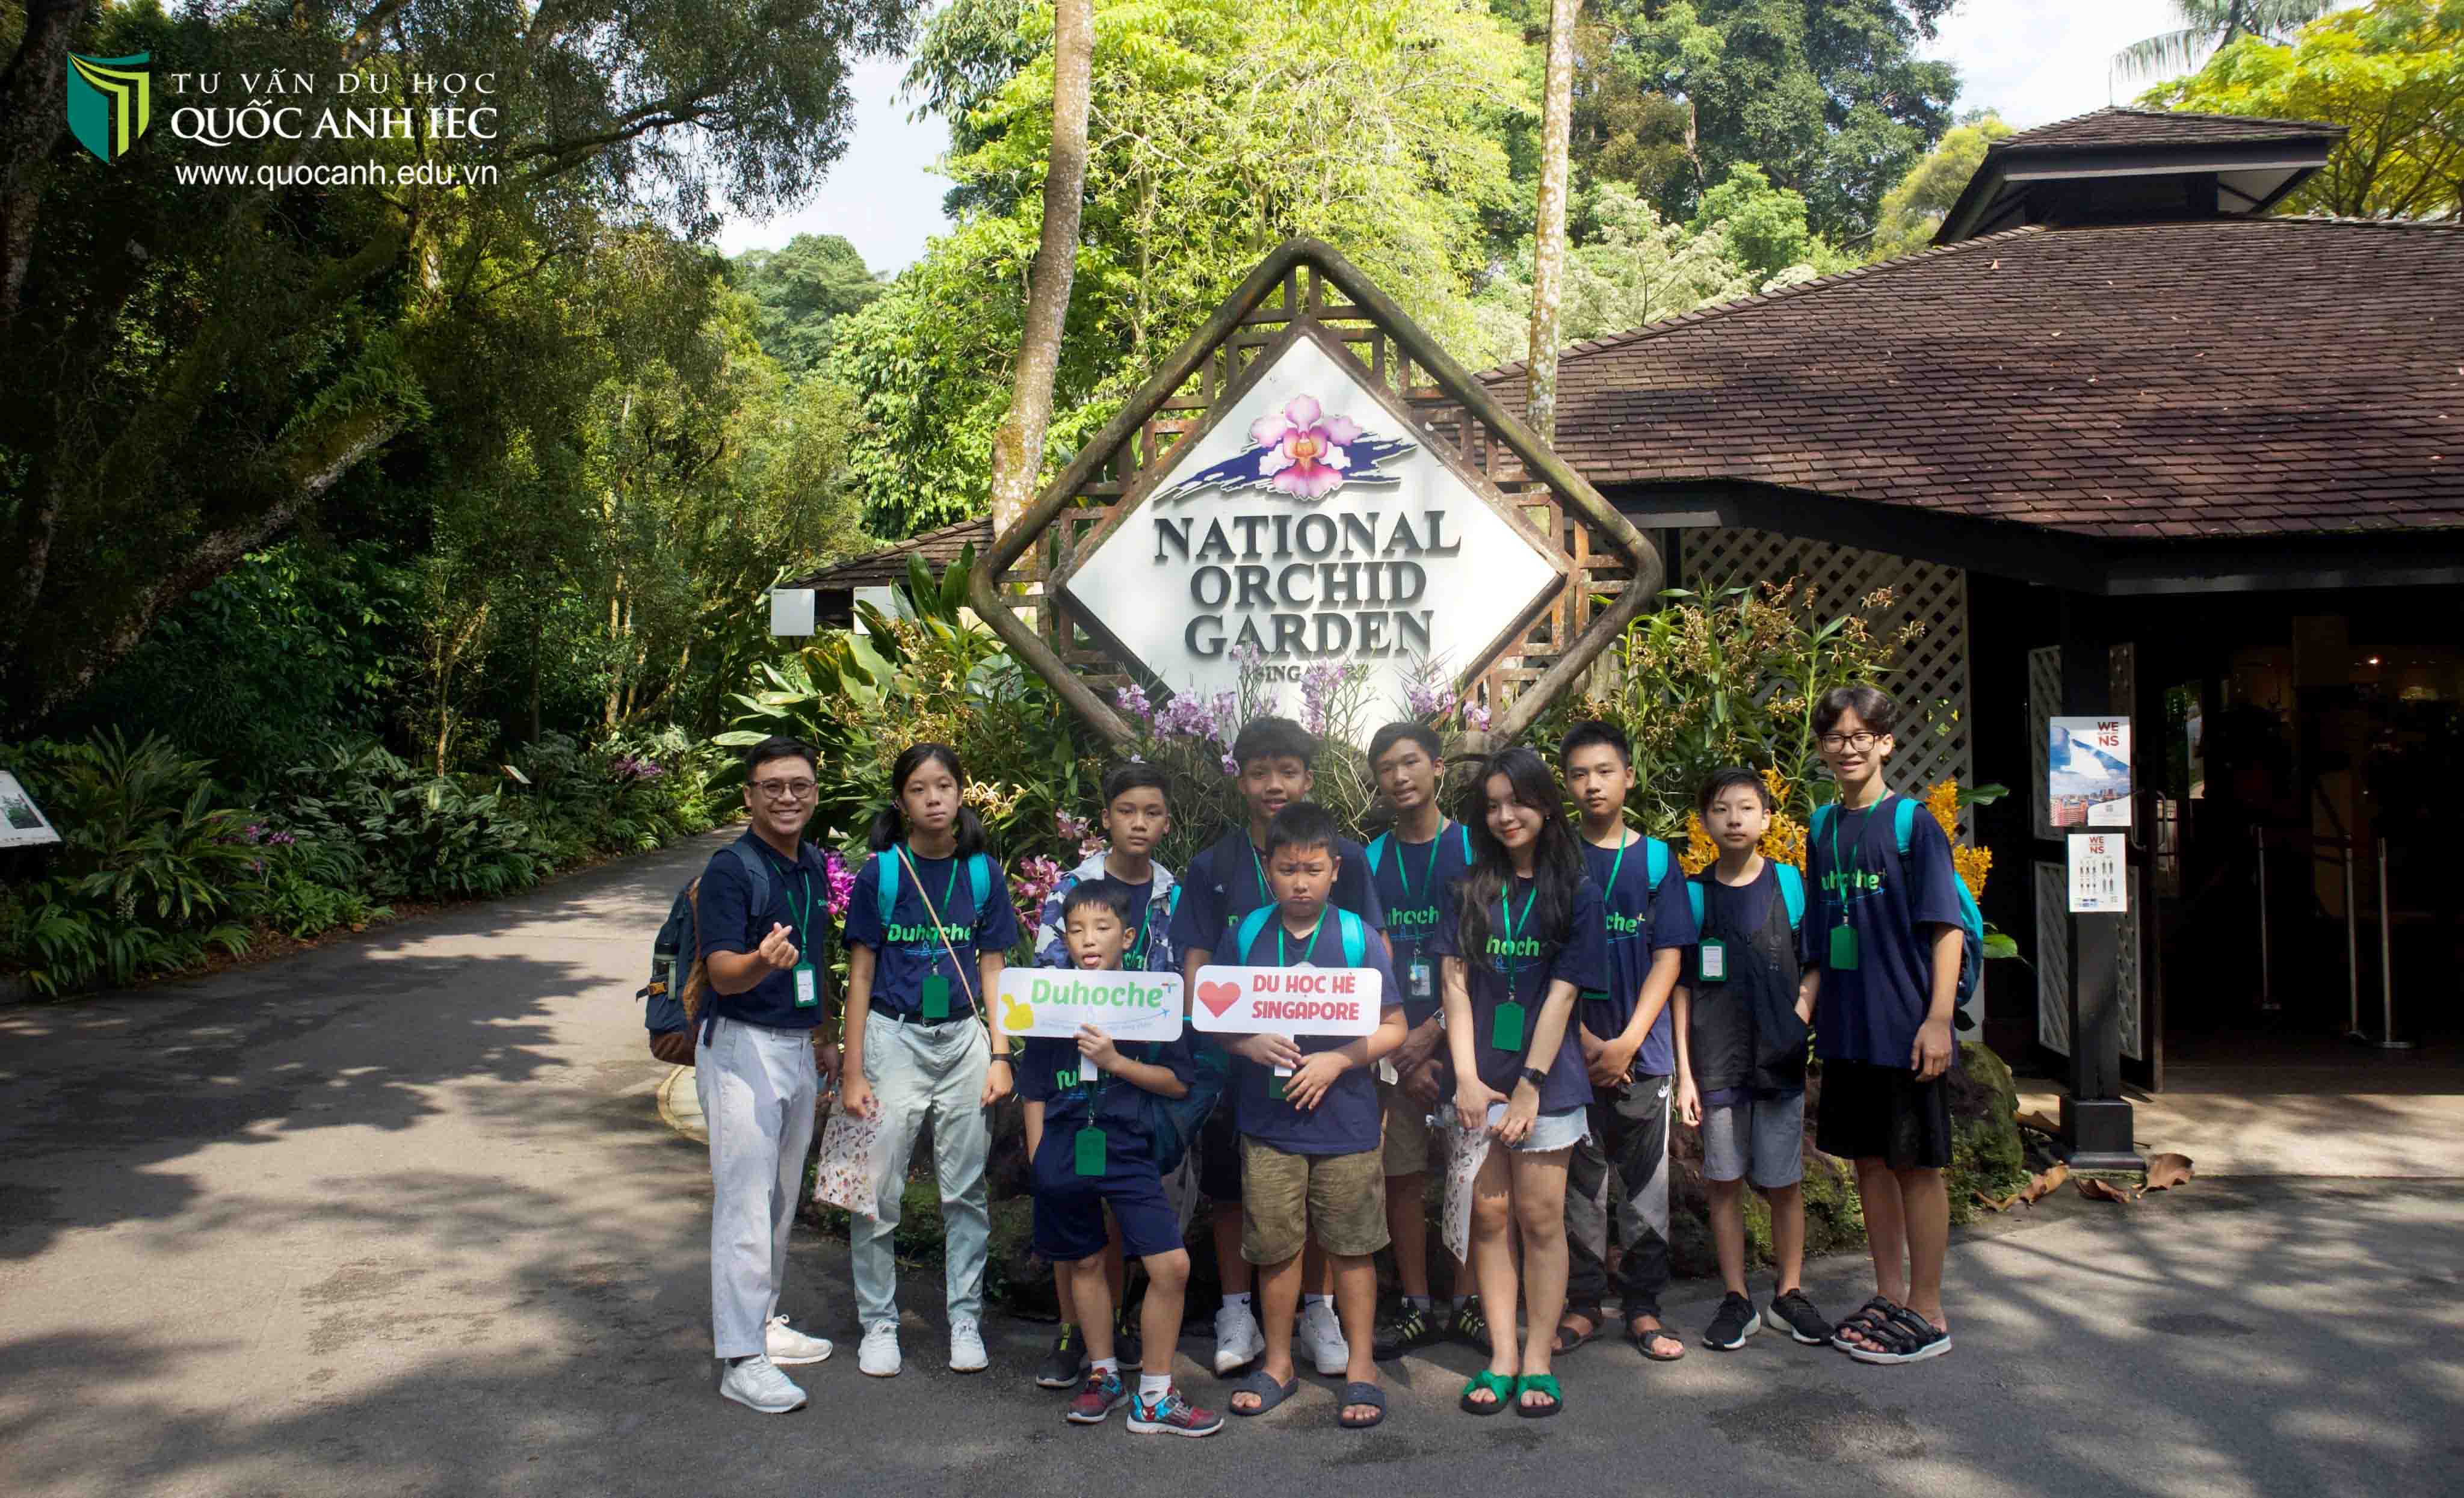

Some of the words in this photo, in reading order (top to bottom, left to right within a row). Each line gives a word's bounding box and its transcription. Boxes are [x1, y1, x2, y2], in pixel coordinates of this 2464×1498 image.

[1153, 510, 1462, 559] NATIONAL
[1190, 560, 1427, 608] ORCHID
[1184, 609, 1434, 659] GARDEN
[1252, 974, 1280, 993] DU
[1285, 975, 1327, 997] HỌC
[1332, 972, 1356, 994] HÈ
[1251, 1000, 1360, 1021] SINGAPORE
